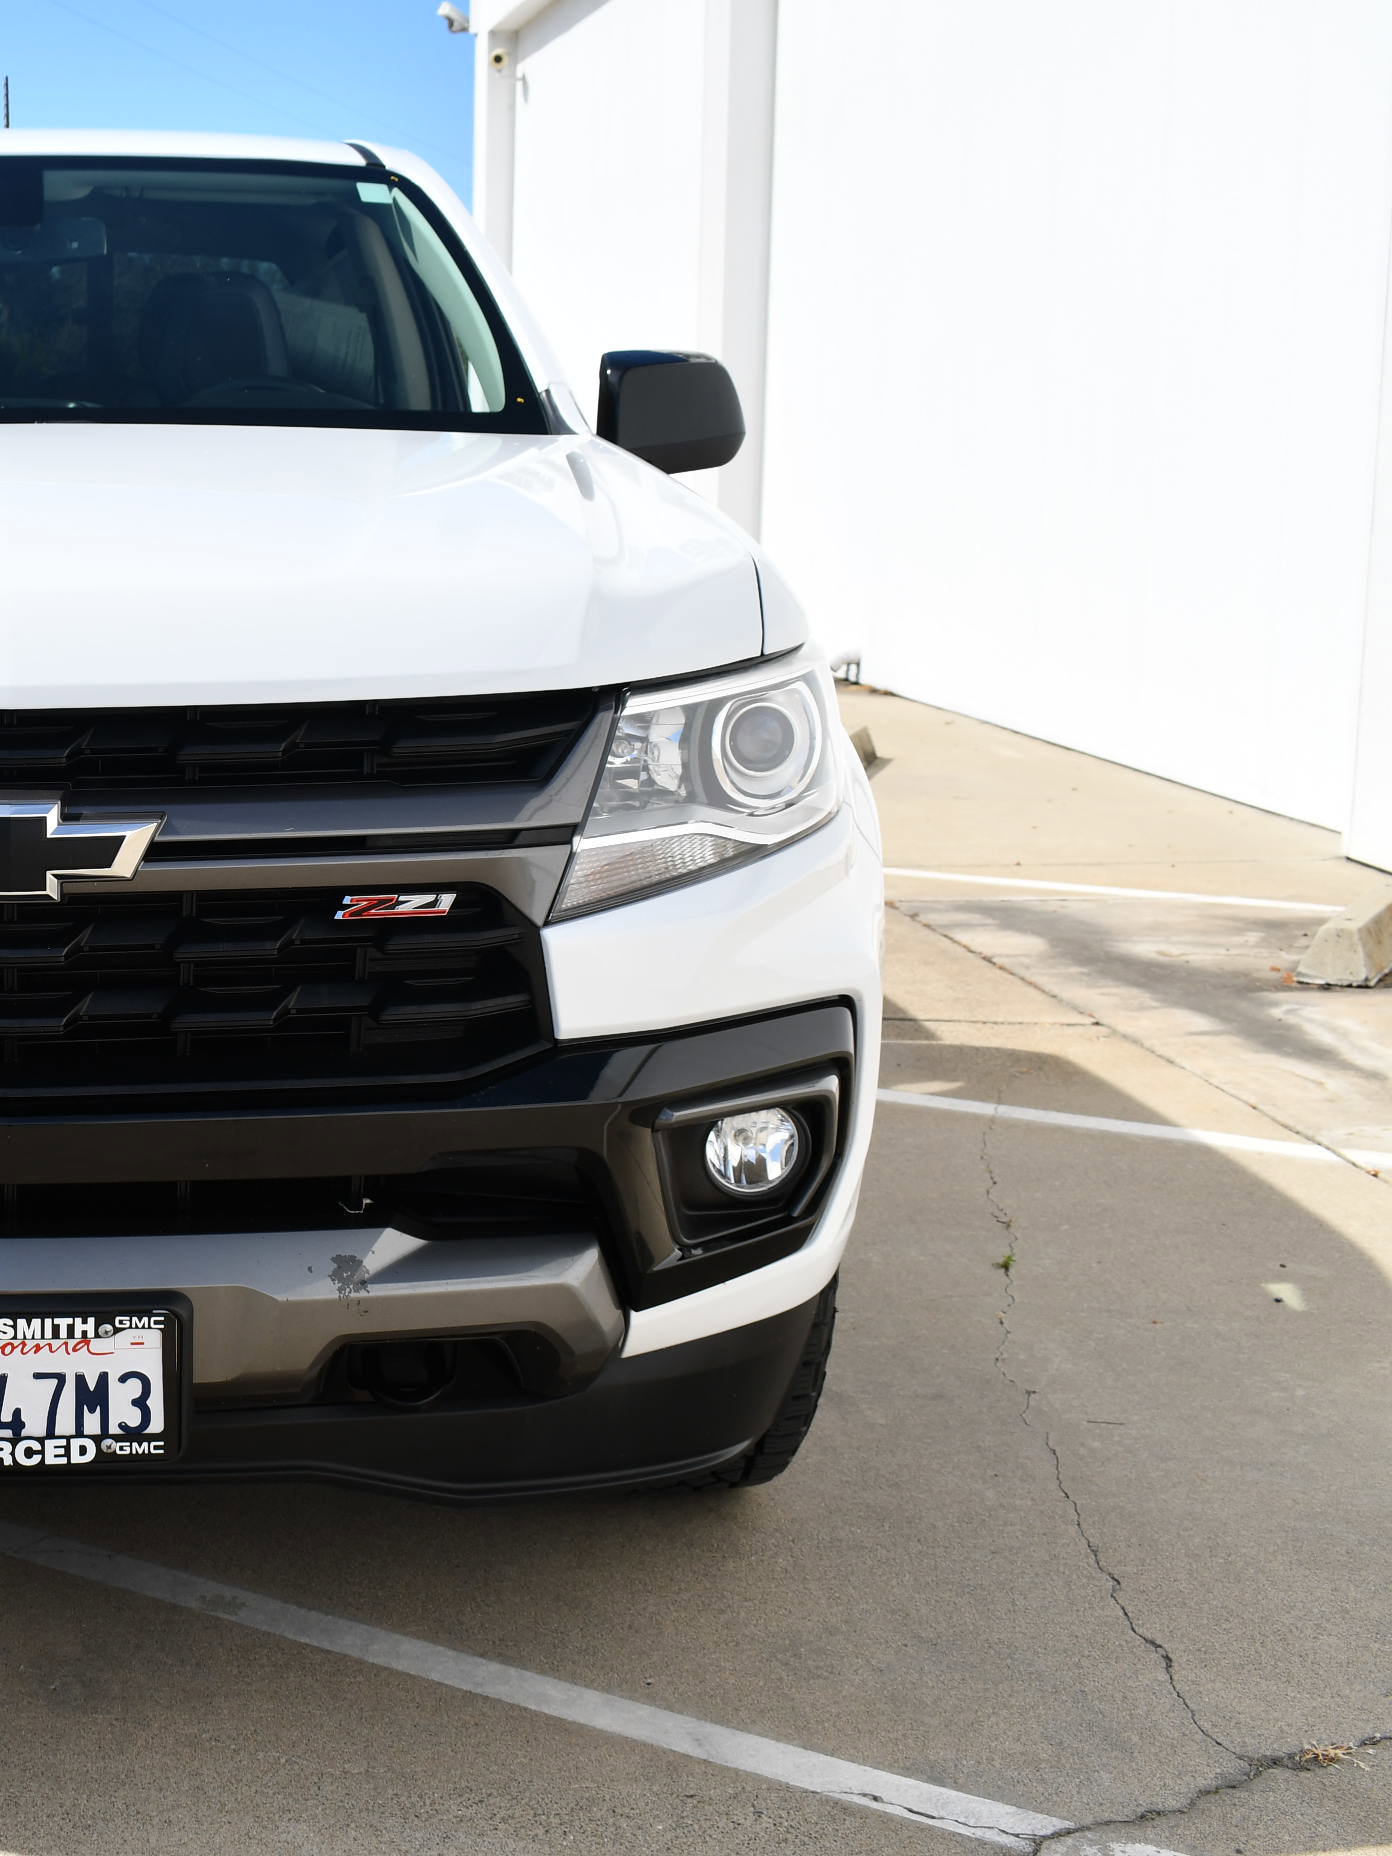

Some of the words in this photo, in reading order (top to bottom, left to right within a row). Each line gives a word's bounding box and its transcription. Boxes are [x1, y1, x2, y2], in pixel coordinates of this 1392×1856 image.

[334, 893, 457, 920] Z71
[115, 1316, 165, 1329] GMC
[115, 1441, 165, 1455] GMC
